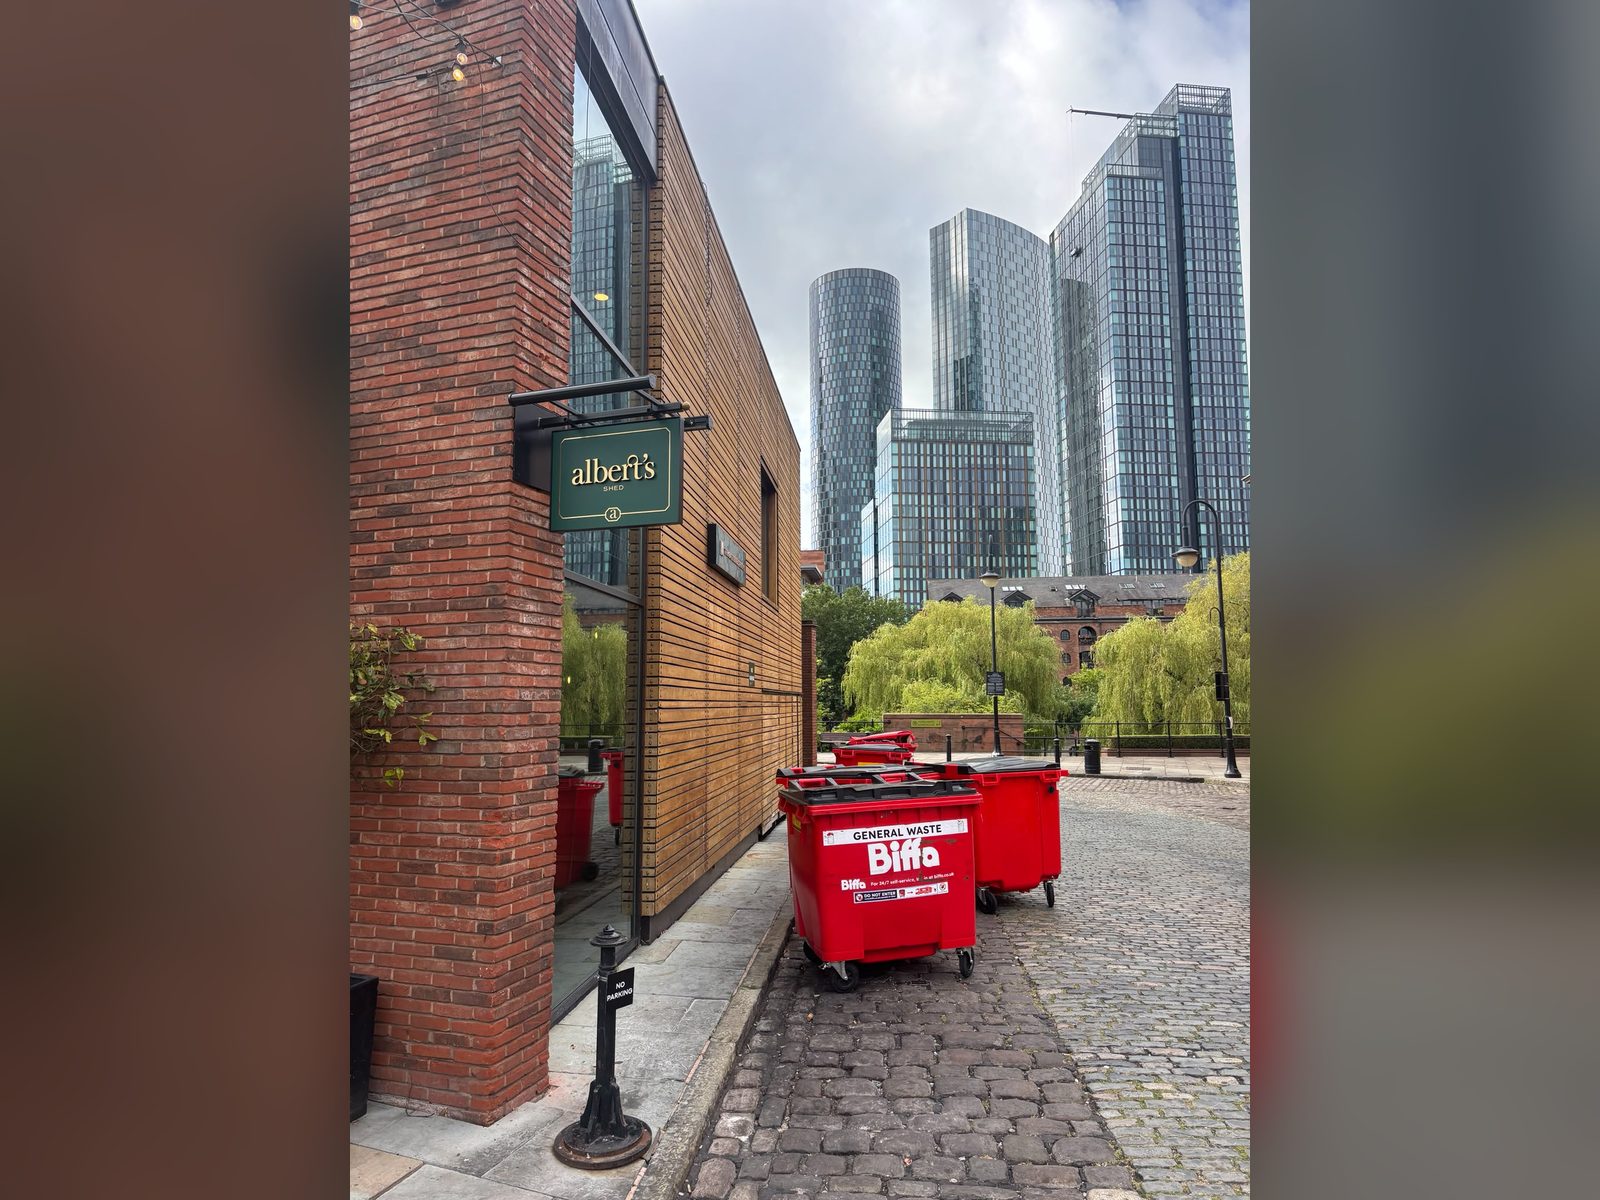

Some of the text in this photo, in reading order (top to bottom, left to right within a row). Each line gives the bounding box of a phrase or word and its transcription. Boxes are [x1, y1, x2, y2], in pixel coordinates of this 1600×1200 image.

[571, 453, 655, 486] albert's
[603, 484, 624, 492] SHED
[853, 824, 942, 841] GENERAL WASTE
[867, 837, 940, 876] Biffa
[840, 878, 866, 891] Biffa
[616, 981, 625, 989] NO
[607, 988, 632, 1002] PARKING
